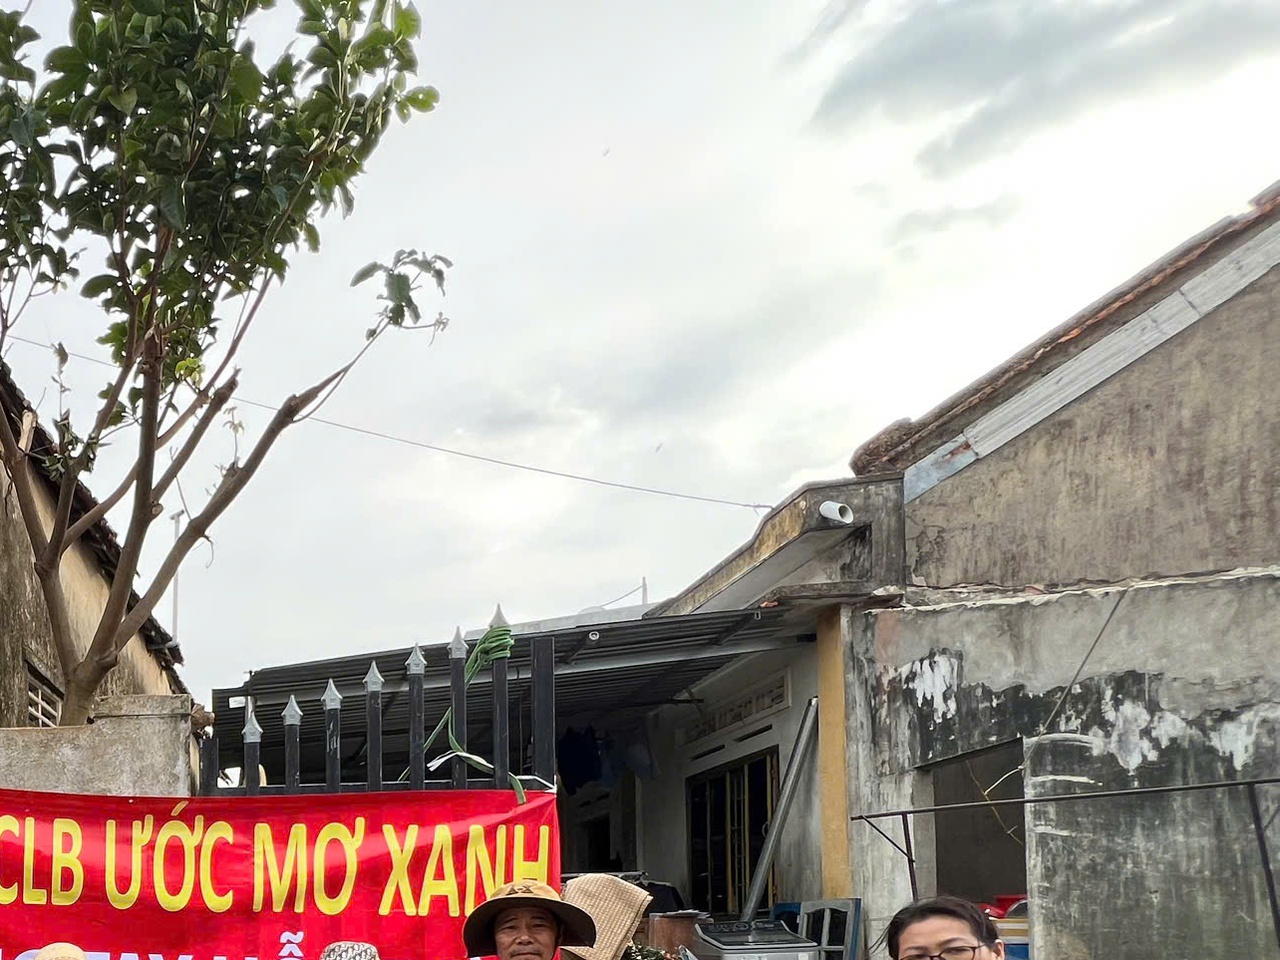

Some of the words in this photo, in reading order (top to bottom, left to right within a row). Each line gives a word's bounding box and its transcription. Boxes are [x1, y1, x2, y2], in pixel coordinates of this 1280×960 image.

[104, 800, 234, 914] ƯỚC
[253, 816, 365, 916] MƠ
[378, 823, 550, 918] XANH
